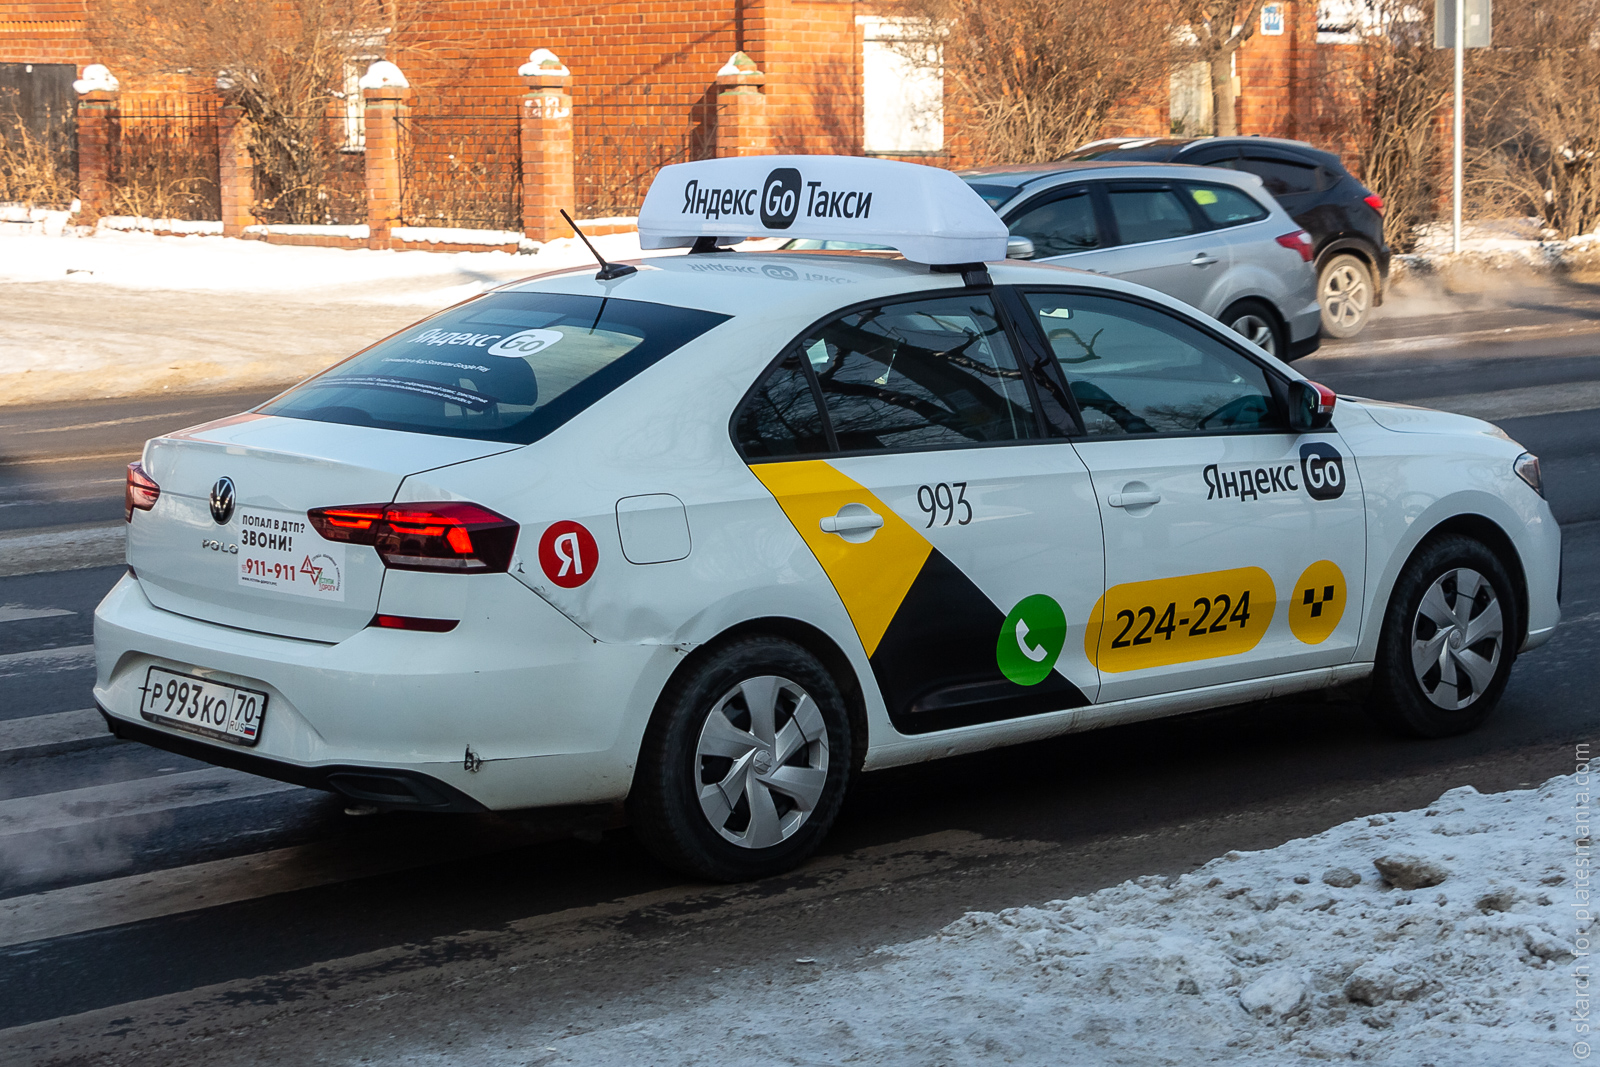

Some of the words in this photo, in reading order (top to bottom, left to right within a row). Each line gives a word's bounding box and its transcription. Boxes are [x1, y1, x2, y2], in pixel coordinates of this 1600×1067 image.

[681, 179, 757, 220] Яндекс
[763, 179, 795, 217] Go
[806, 181, 873, 219] Такси
[407, 328, 501, 347] Яндекс
[500, 334, 546, 352] Go
[1202, 461, 1299, 502] Яндекс
[1304, 453, 1341, 489] Go
[917, 481, 973, 529] 993
[242, 514, 272, 530] ПОПАЛ
[274, 520, 279, 530] В
[281, 522, 305, 534] ДТП?
[202, 539, 239, 555] POLO
[241, 529, 293, 552] ЗВОНИ!
[557, 532, 583, 577] Я
[246, 558, 295, 582] 911-911
[1111, 590, 1251, 650] 224-224
[235, 693, 256, 723] 70
[229, 720, 244, 733] RUS
